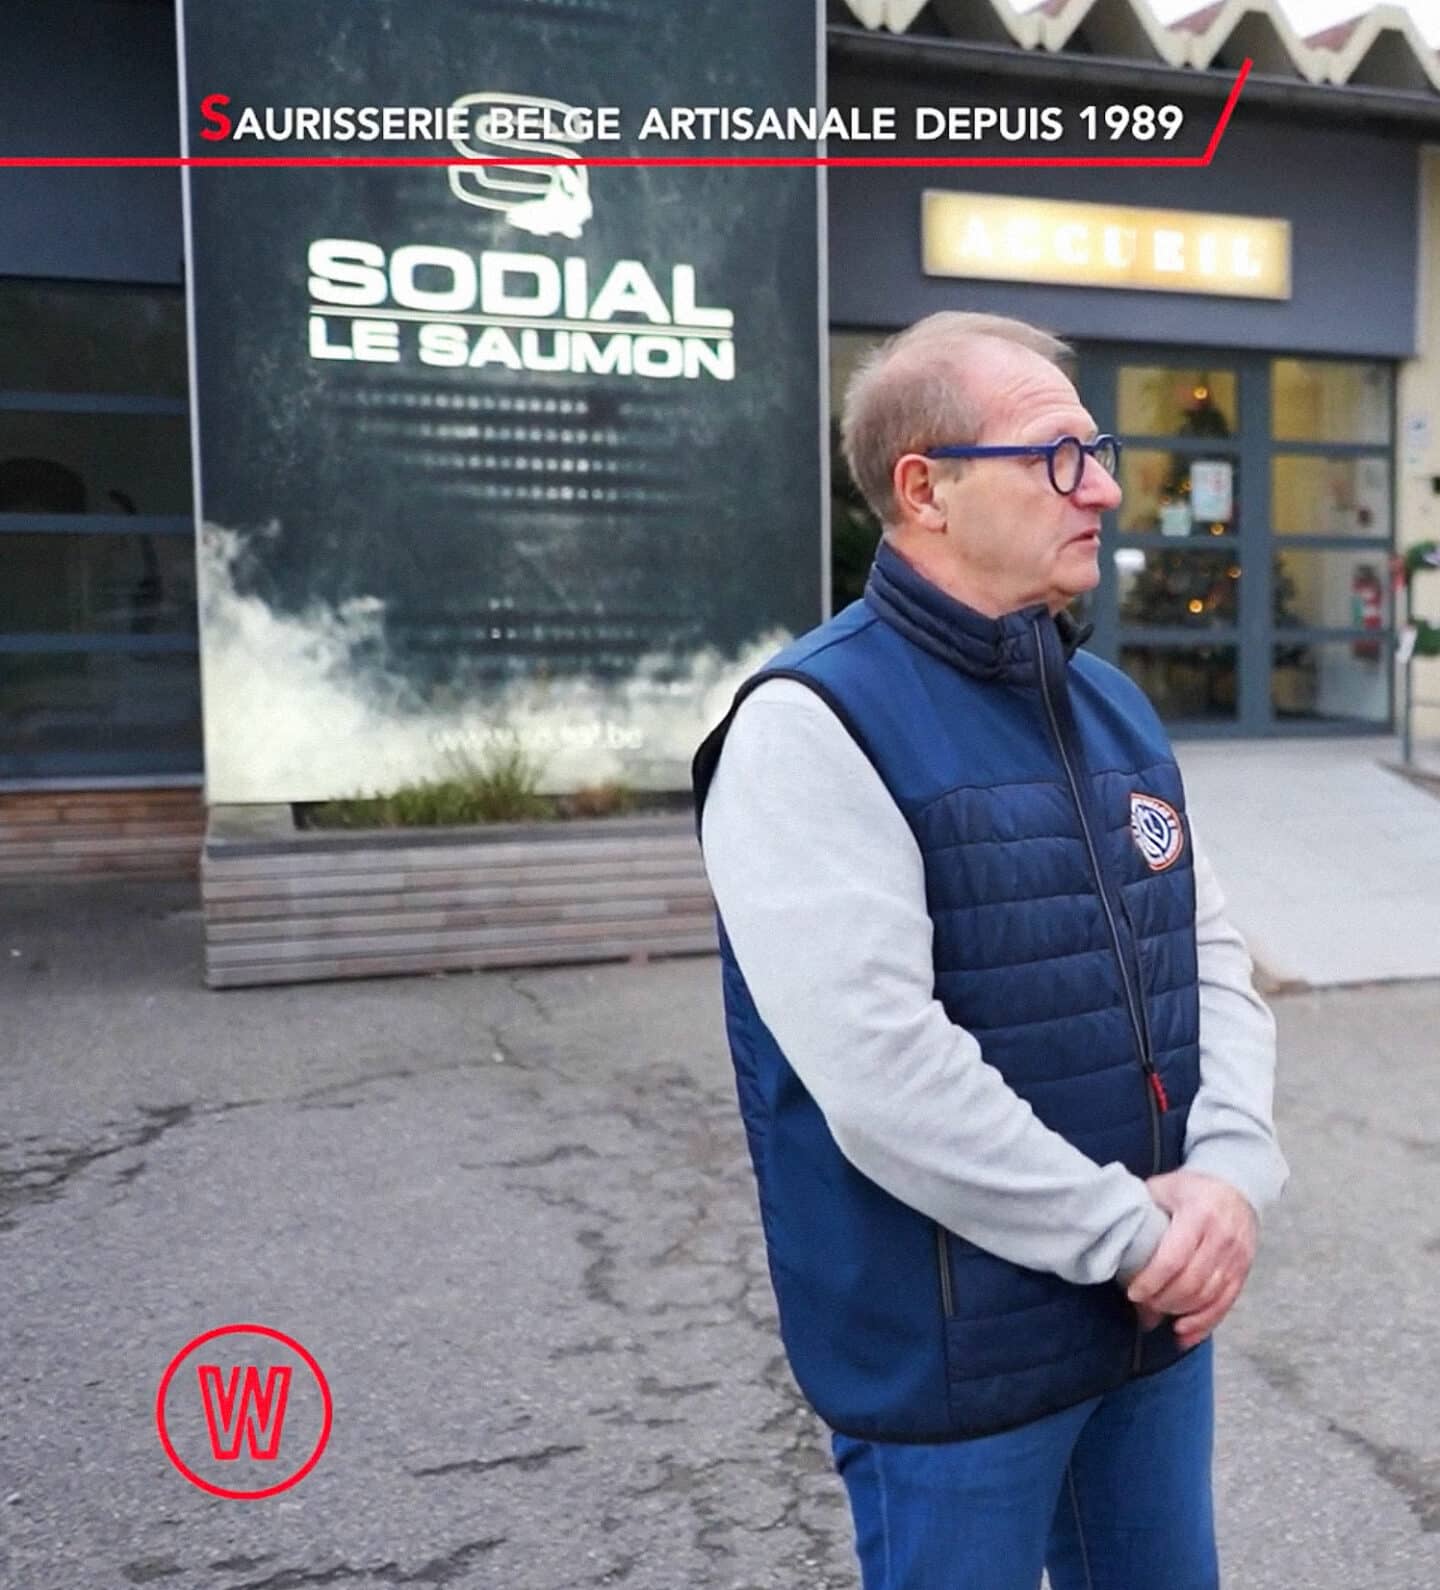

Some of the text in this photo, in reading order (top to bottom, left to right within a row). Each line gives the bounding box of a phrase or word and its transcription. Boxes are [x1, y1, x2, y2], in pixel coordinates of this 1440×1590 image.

[958, 212, 1266, 280] ACCUEIL
[307, 238, 735, 327] SODIAL
[308, 316, 736, 381] LE SAUMON
